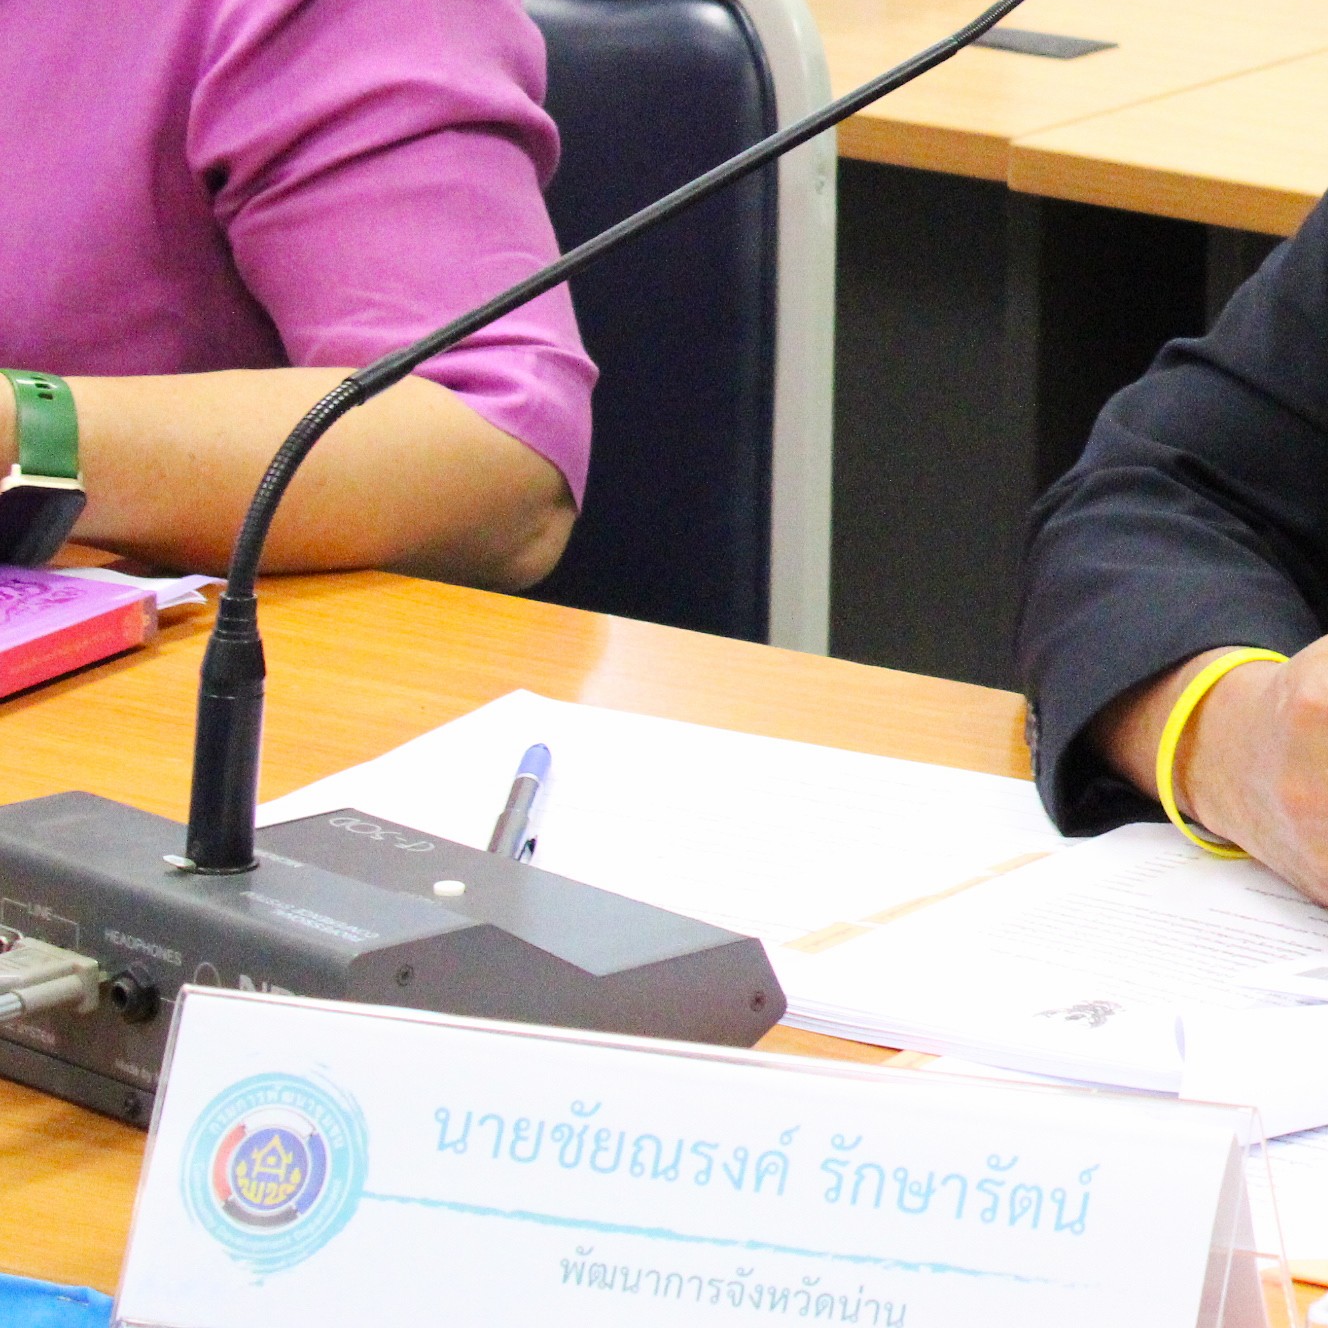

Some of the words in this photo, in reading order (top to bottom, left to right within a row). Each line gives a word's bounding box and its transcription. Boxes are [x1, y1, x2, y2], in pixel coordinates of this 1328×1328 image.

[434, 1099, 801, 1197] นายชัยณรงค์
[820, 1133, 1100, 1236] รักษารัตน์
[560, 1245, 907, 1328] พัฒนาการจังหวัดน่าน
